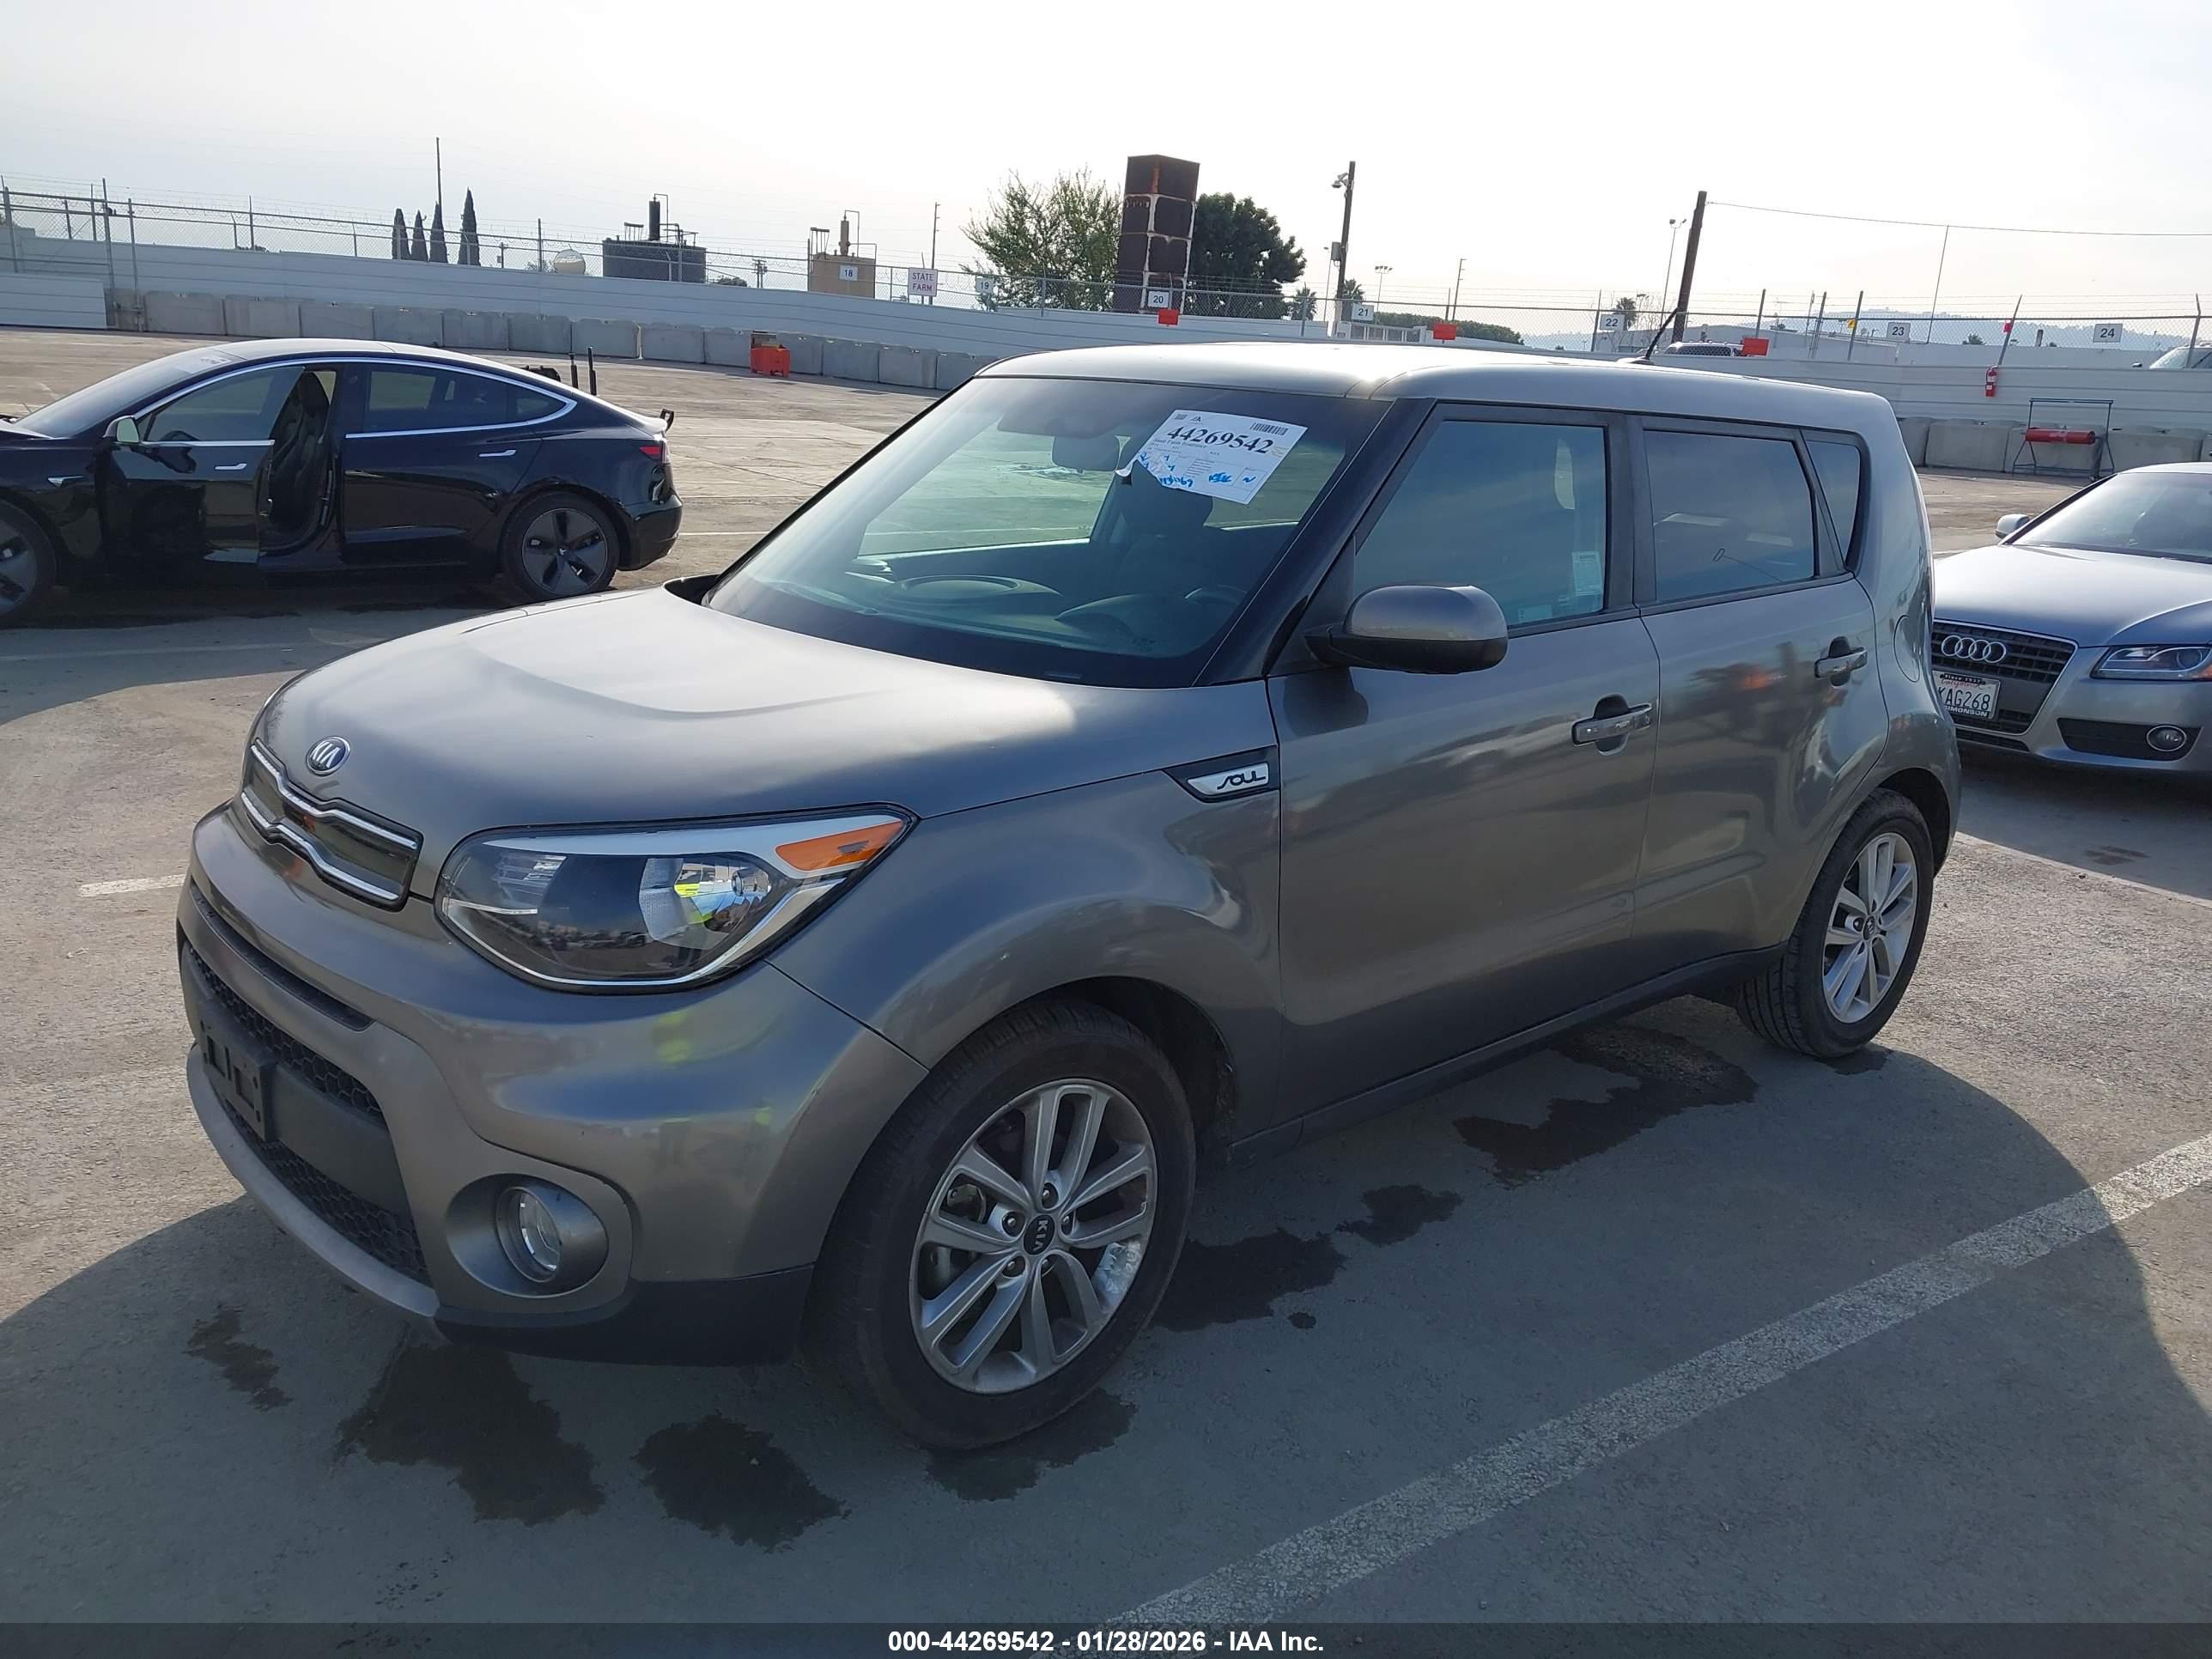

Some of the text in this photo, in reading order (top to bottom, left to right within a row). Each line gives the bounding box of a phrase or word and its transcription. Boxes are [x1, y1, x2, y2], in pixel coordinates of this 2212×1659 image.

[843, 269, 854, 278] 18
[912, 272, 935, 282] STATE
[912, 283, 933, 292] FARM
[980, 281, 990, 290] 19
[1152, 295, 1164, 305] 20
[1358, 307, 1370, 317] 21
[1605, 318, 1619, 327] 22
[1892, 325, 1905, 337] 23
[2100, 327, 2115, 338] 24
[1167, 426, 1274, 454] 44269542
[1216, 770, 1267, 790] SOUL
[1032, 1219, 1048, 1252] KIA
